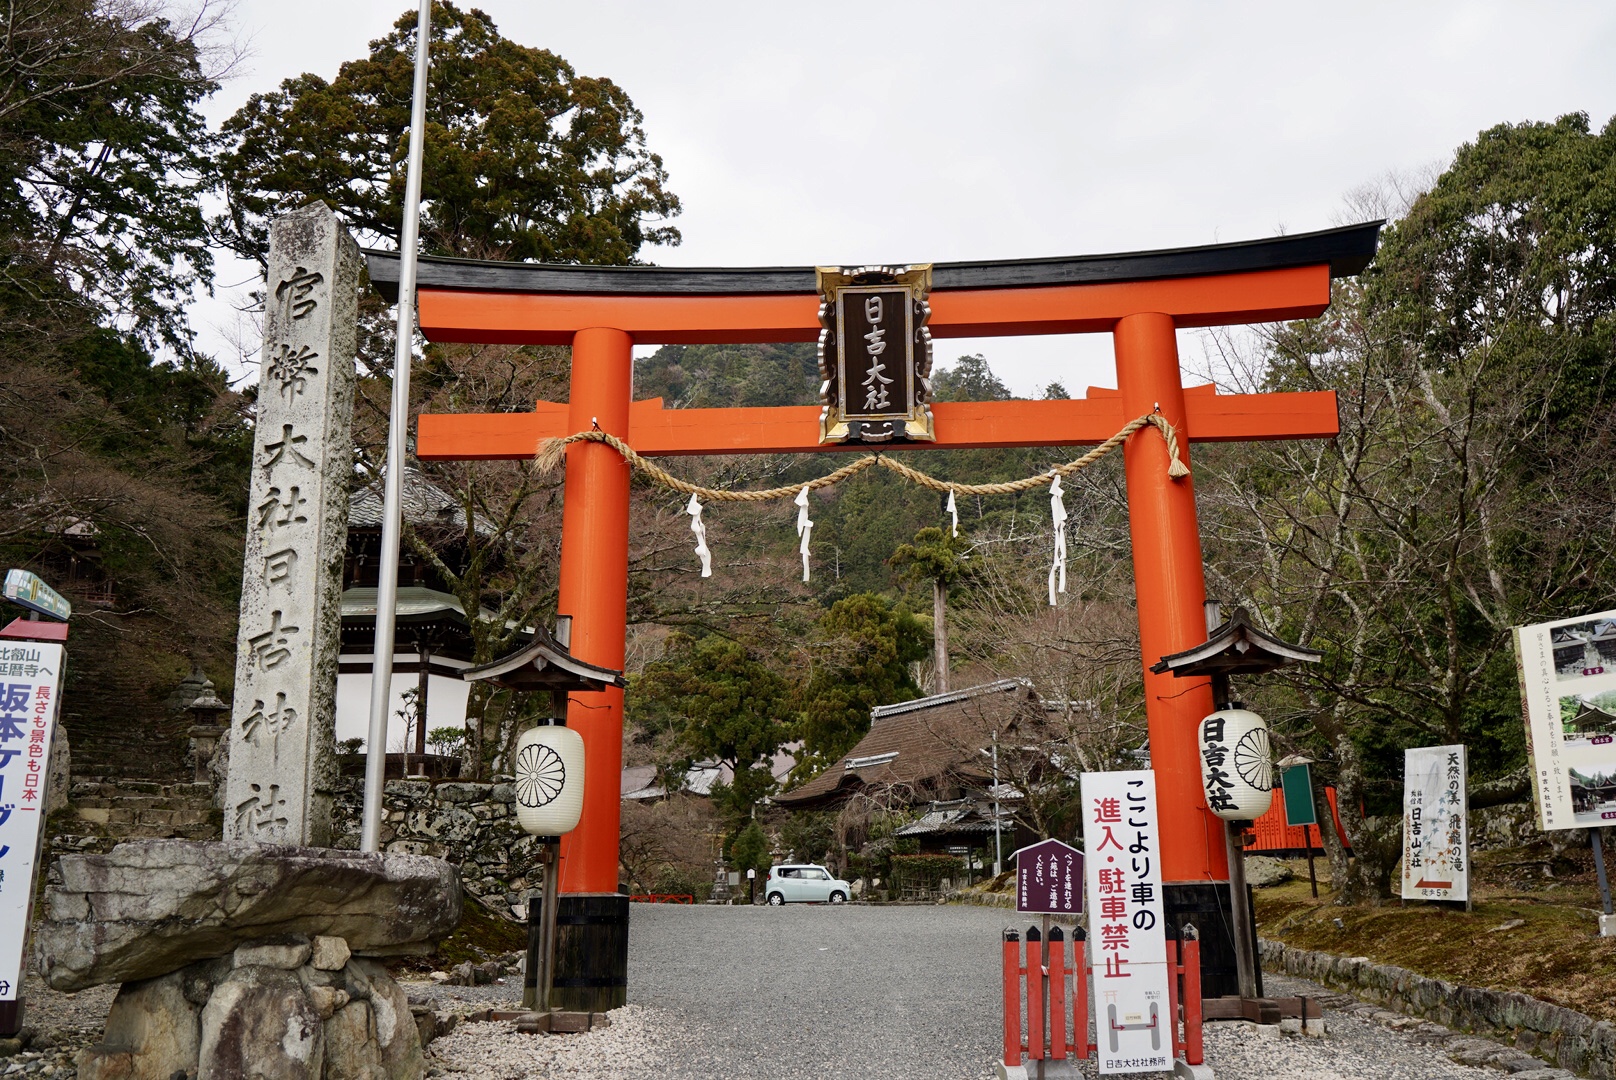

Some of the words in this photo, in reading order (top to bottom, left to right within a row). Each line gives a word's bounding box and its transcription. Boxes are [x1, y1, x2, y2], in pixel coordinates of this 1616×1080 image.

[861, 296, 894, 410] 日吉大社
[235, 266, 324, 831] 官幣大社日吉神社
[20, 686, 51, 811] 長さも景色も日本一
[1202, 717, 1239, 812] 日吉大社
[1447, 752, 1461, 805] 天然の美
[1541, 771, 1554, 824] 日吉大社社務所
[1035, 854, 1044, 886] ください。
[1064, 853, 1073, 909] ペットを連れての
[1126, 780, 1156, 931] ここより車の
[1449, 813, 1464, 872] 飛龍の滝
[1093, 797, 1132, 979] 進入・駐車禁止
[1106, 1057, 1166, 1069] 日吉大社社務所
